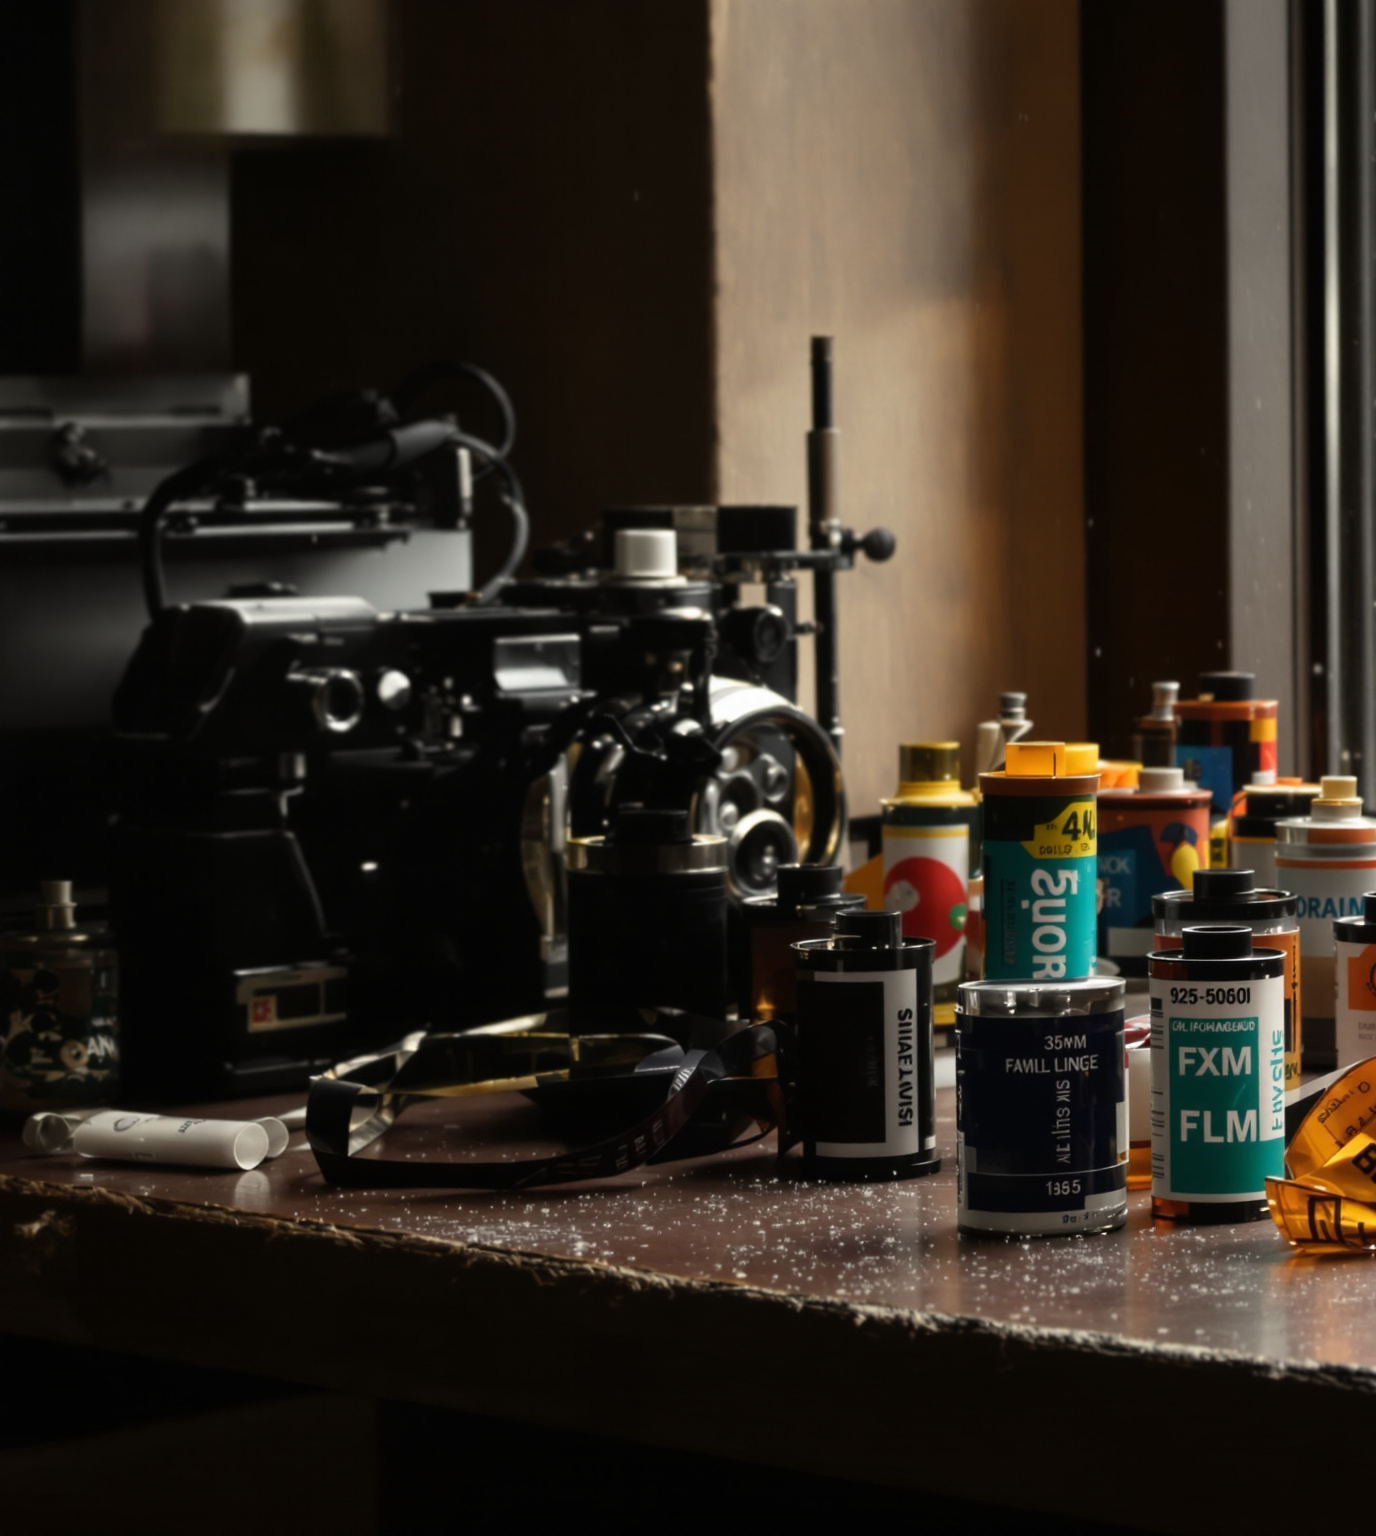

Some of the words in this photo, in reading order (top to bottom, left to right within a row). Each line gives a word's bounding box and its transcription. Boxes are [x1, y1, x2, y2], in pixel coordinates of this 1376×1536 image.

[1054, 1054, 1099, 1072] LINGE
[1178, 1046, 1252, 1077] FXM
[1180, 1109, 1258, 1143] FLM
